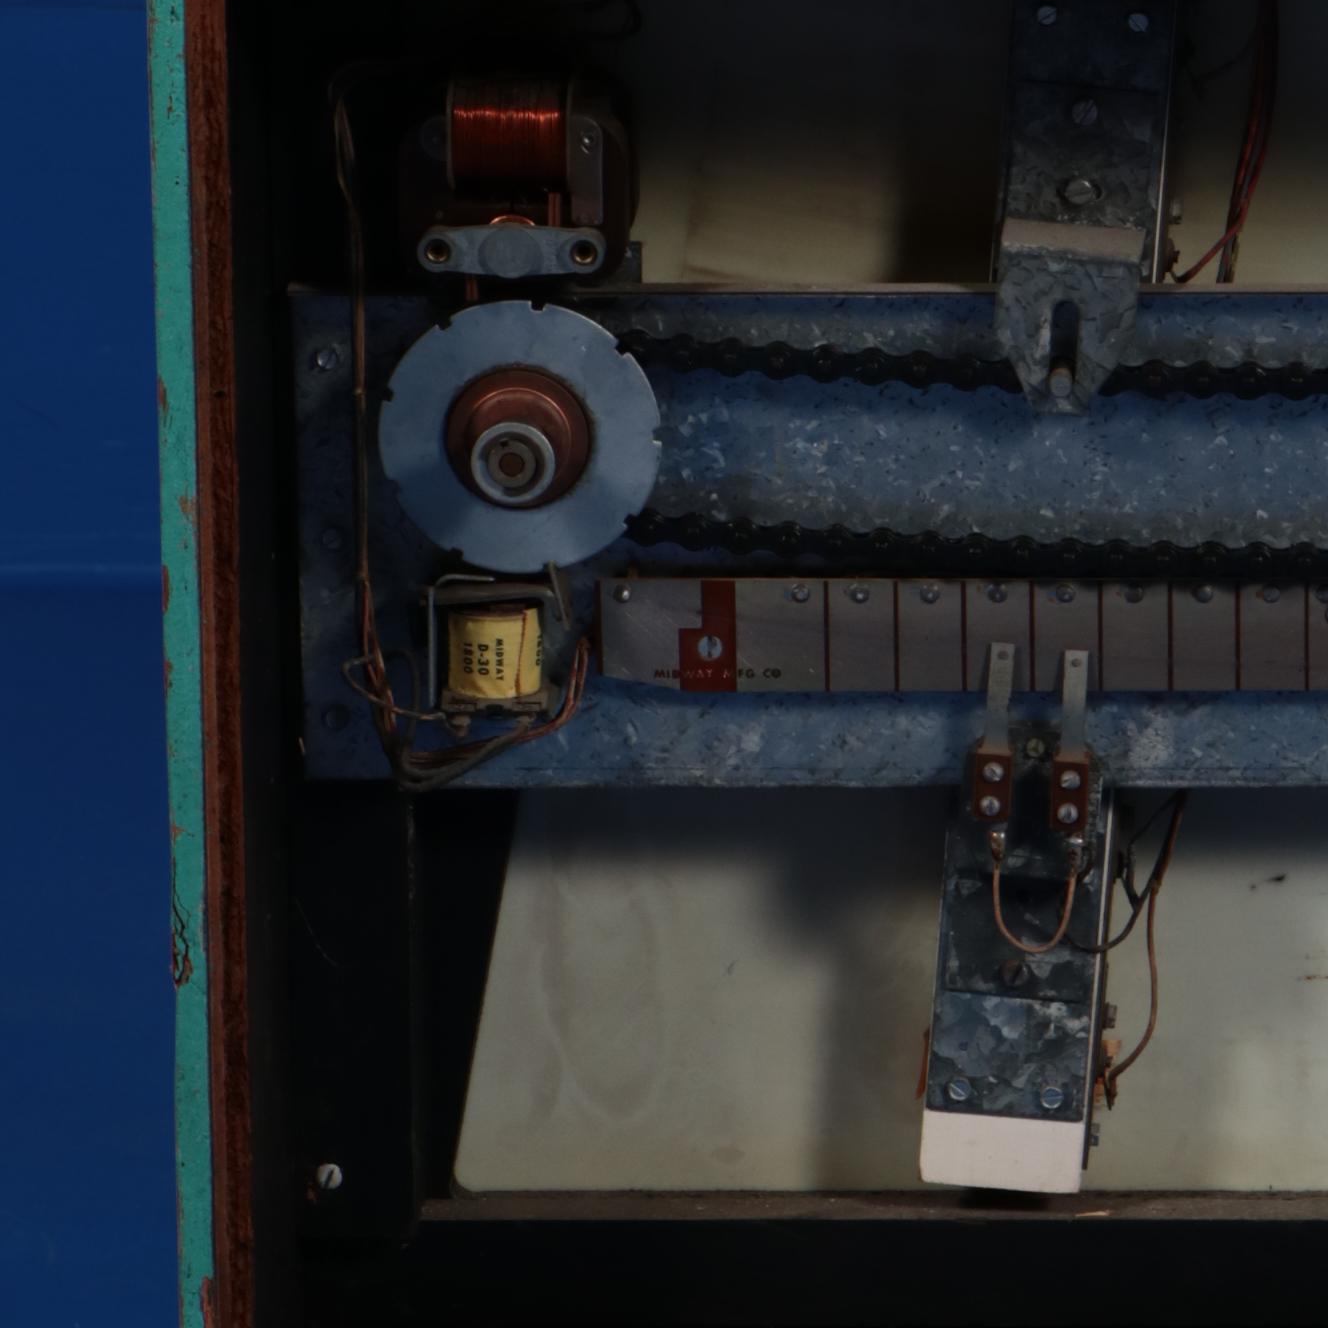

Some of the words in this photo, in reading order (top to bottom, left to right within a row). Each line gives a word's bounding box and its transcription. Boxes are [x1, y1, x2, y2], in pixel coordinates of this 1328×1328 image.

[477, 644, 489, 676] D-30
[496, 638, 504, 681] MIDWAY
[654, 668, 713, 679] MIDWAY
